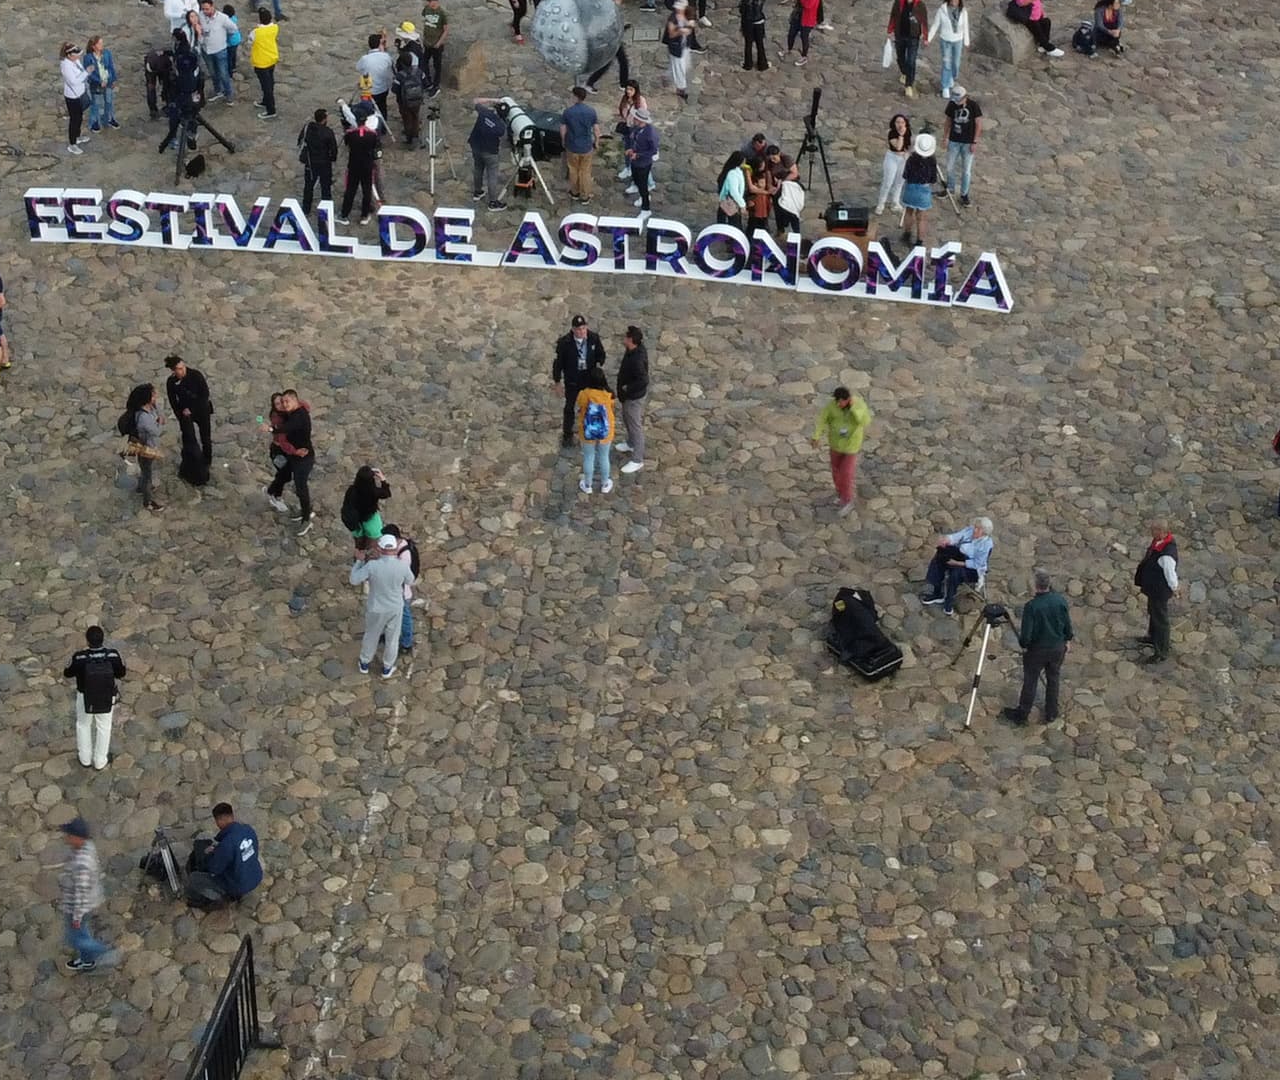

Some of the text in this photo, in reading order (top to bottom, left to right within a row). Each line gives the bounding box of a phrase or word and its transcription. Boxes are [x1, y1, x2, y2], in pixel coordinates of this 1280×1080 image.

[23, 187, 1014, 313] FESTIVAL DE ASTRONOMÍA
